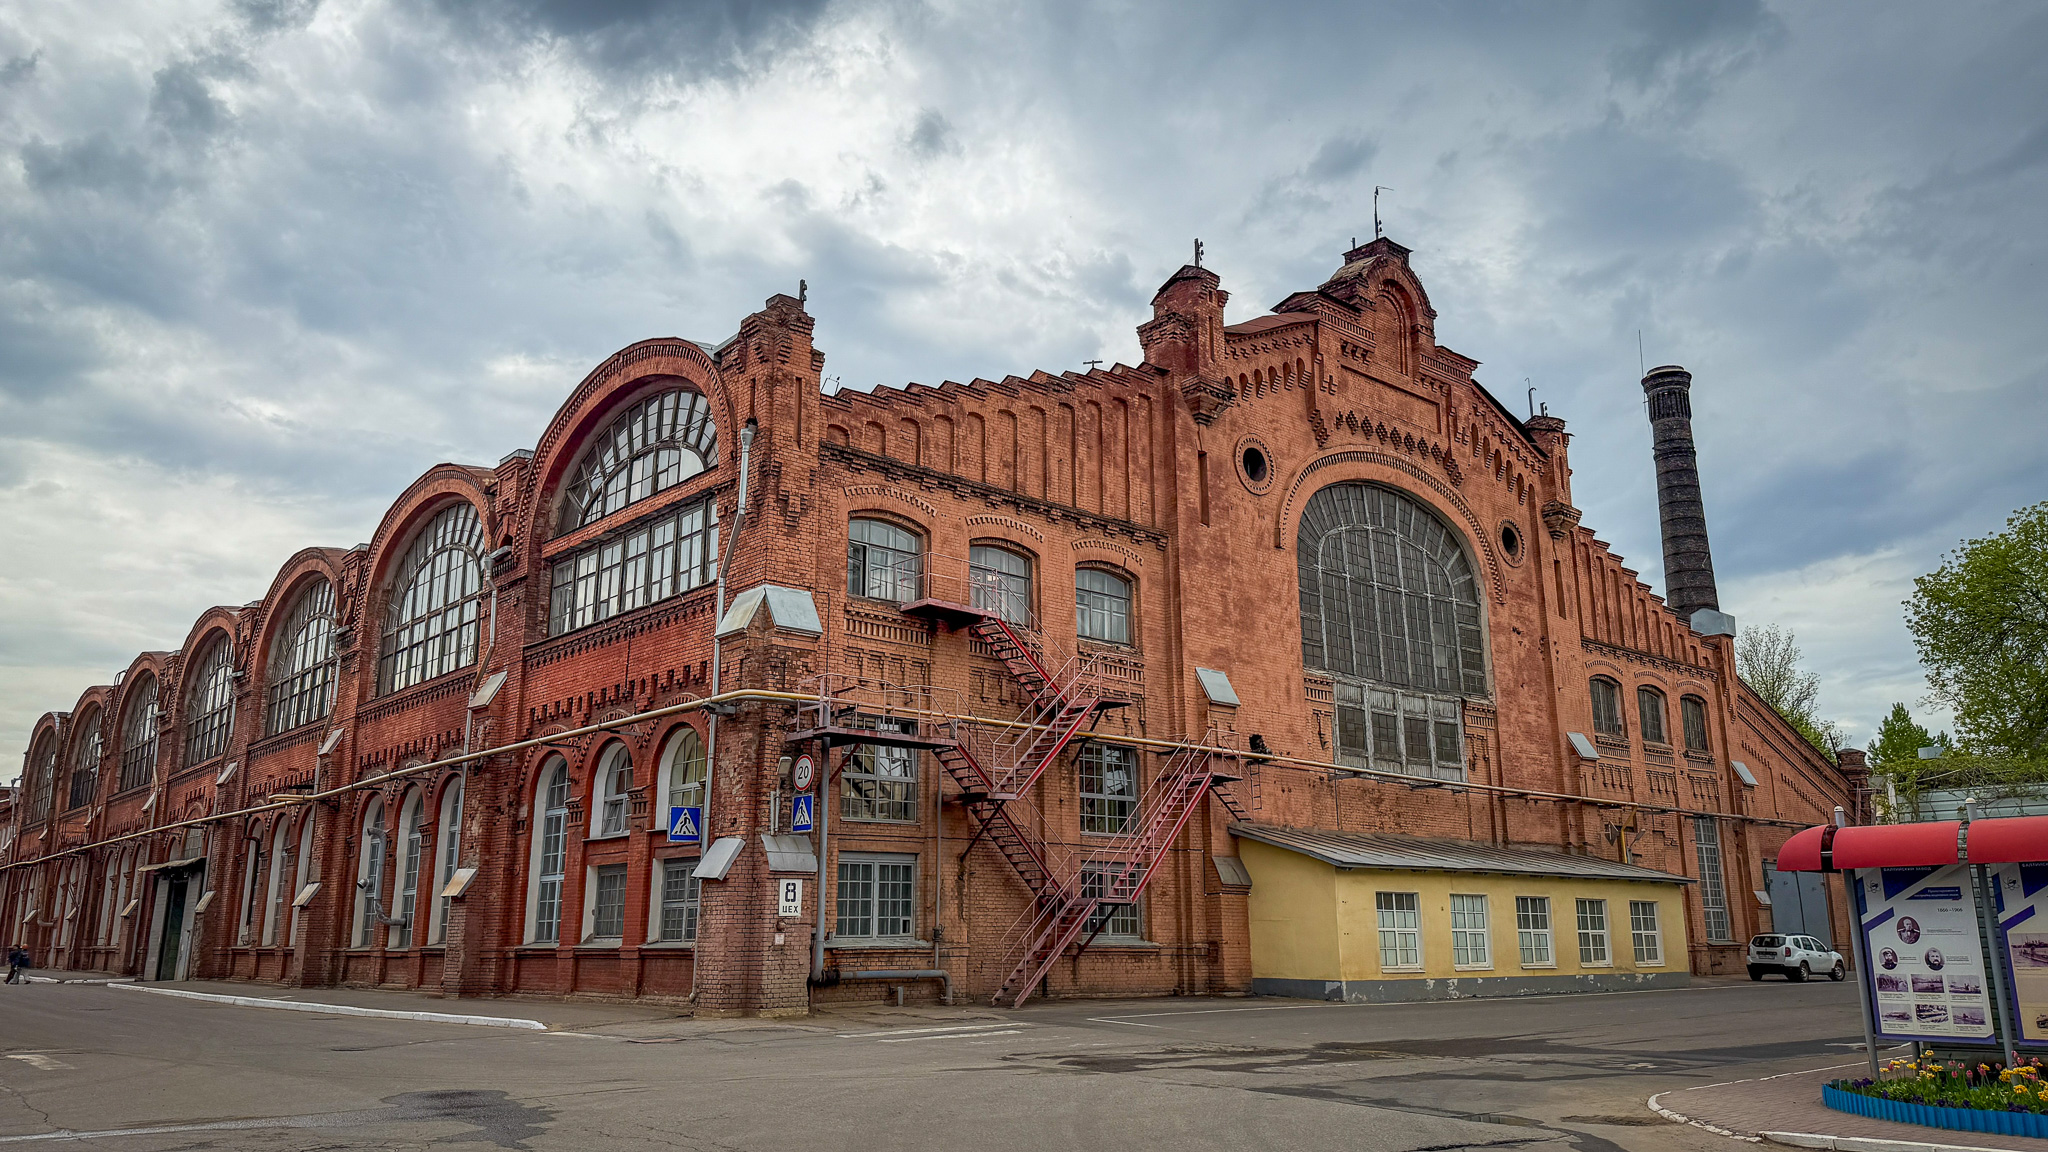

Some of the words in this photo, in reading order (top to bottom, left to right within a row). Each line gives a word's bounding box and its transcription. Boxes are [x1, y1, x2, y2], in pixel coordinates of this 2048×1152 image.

[798, 765, 809, 780] 20
[785, 882, 797, 902] 8
[782, 905, 798, 913] ЦЕХ
